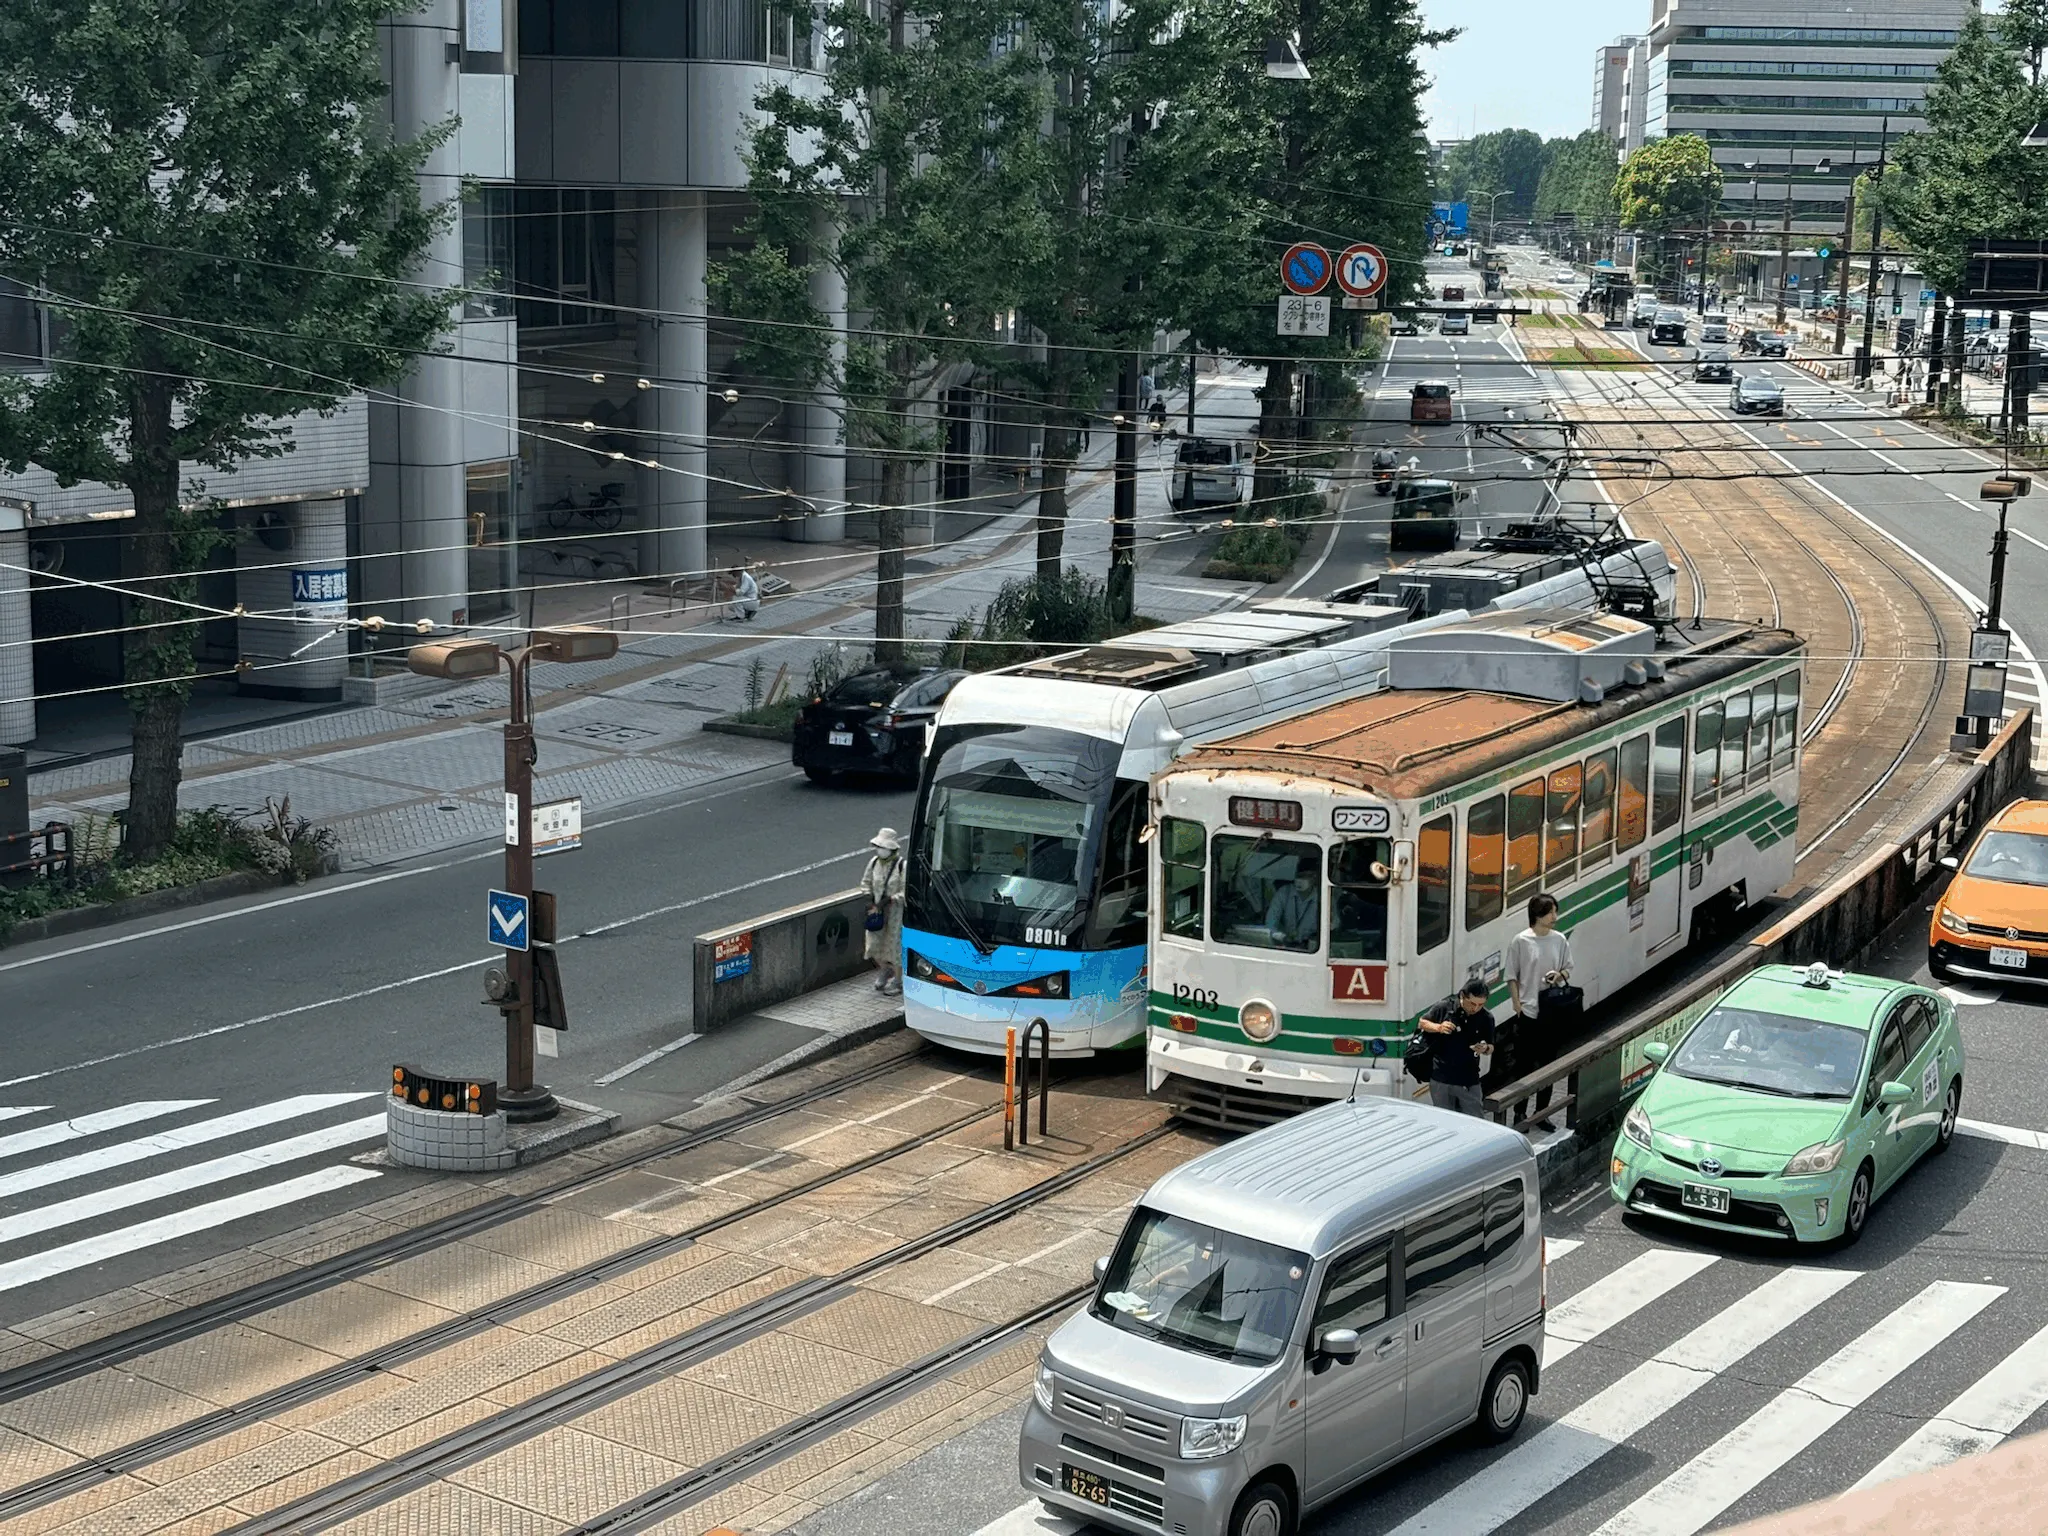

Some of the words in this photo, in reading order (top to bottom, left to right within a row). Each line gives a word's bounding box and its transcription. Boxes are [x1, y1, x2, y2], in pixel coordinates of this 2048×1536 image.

[1235, 799, 1296, 823] 健軍町
[1432, 792, 1448, 811] 1203
[1336, 812, 1386, 826] ワンマン
[1346, 967, 1370, 996] A
[1808, 974, 1823, 983] 147
[1173, 983, 1219, 1012] 1203
[1071, 1477, 1106, 1504] 82-65
